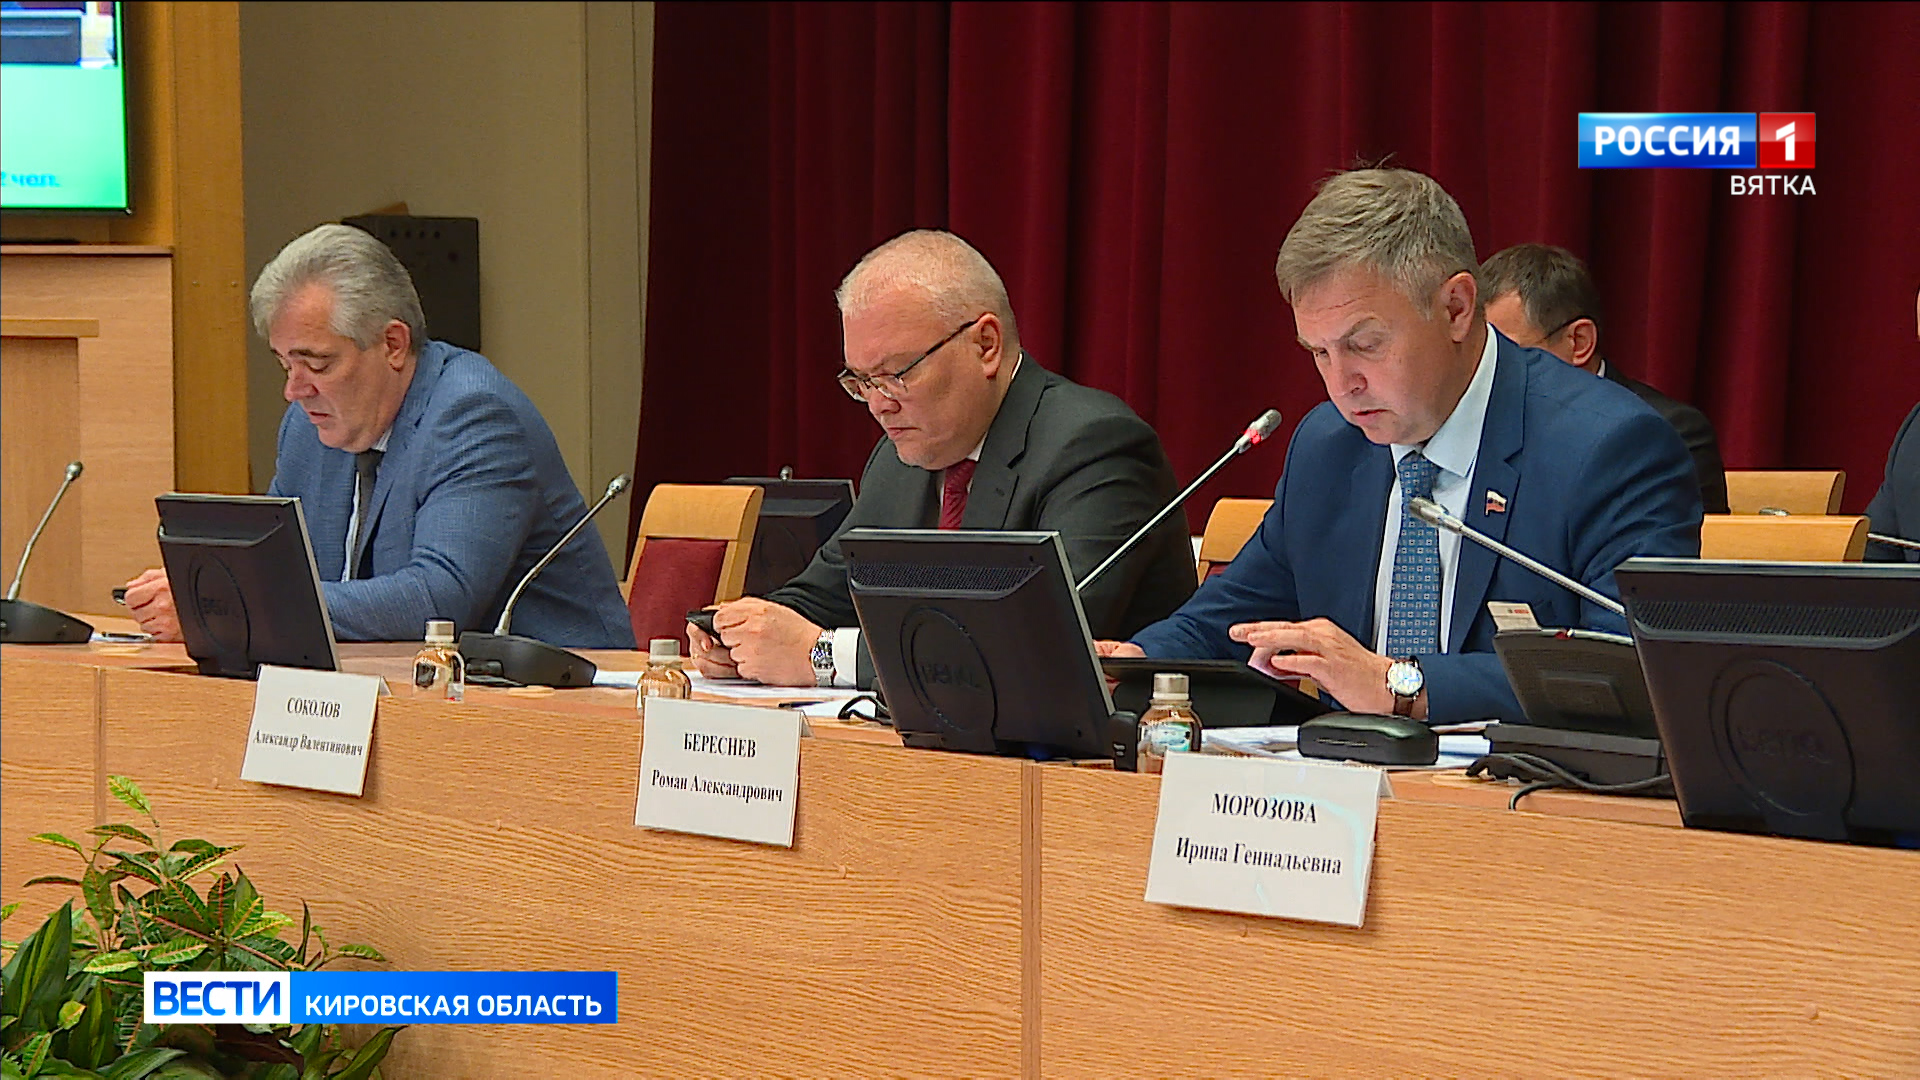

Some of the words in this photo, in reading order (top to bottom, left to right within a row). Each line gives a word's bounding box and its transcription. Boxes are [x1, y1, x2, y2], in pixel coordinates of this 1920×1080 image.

[287, 697, 341, 718] СОКОЛОВ
[253, 730, 299, 752] Александр
[300, 733, 363, 756] Валентинович
[684, 732, 756, 758] БЕРЕСНЕВ
[651, 769, 688, 790] Роман
[690, 774, 783, 803] Александрович
[1211, 793, 1317, 823] МОРОЗОВА
[1176, 837, 1228, 865] Ирина
[1233, 843, 1342, 874] Геннадьевна
